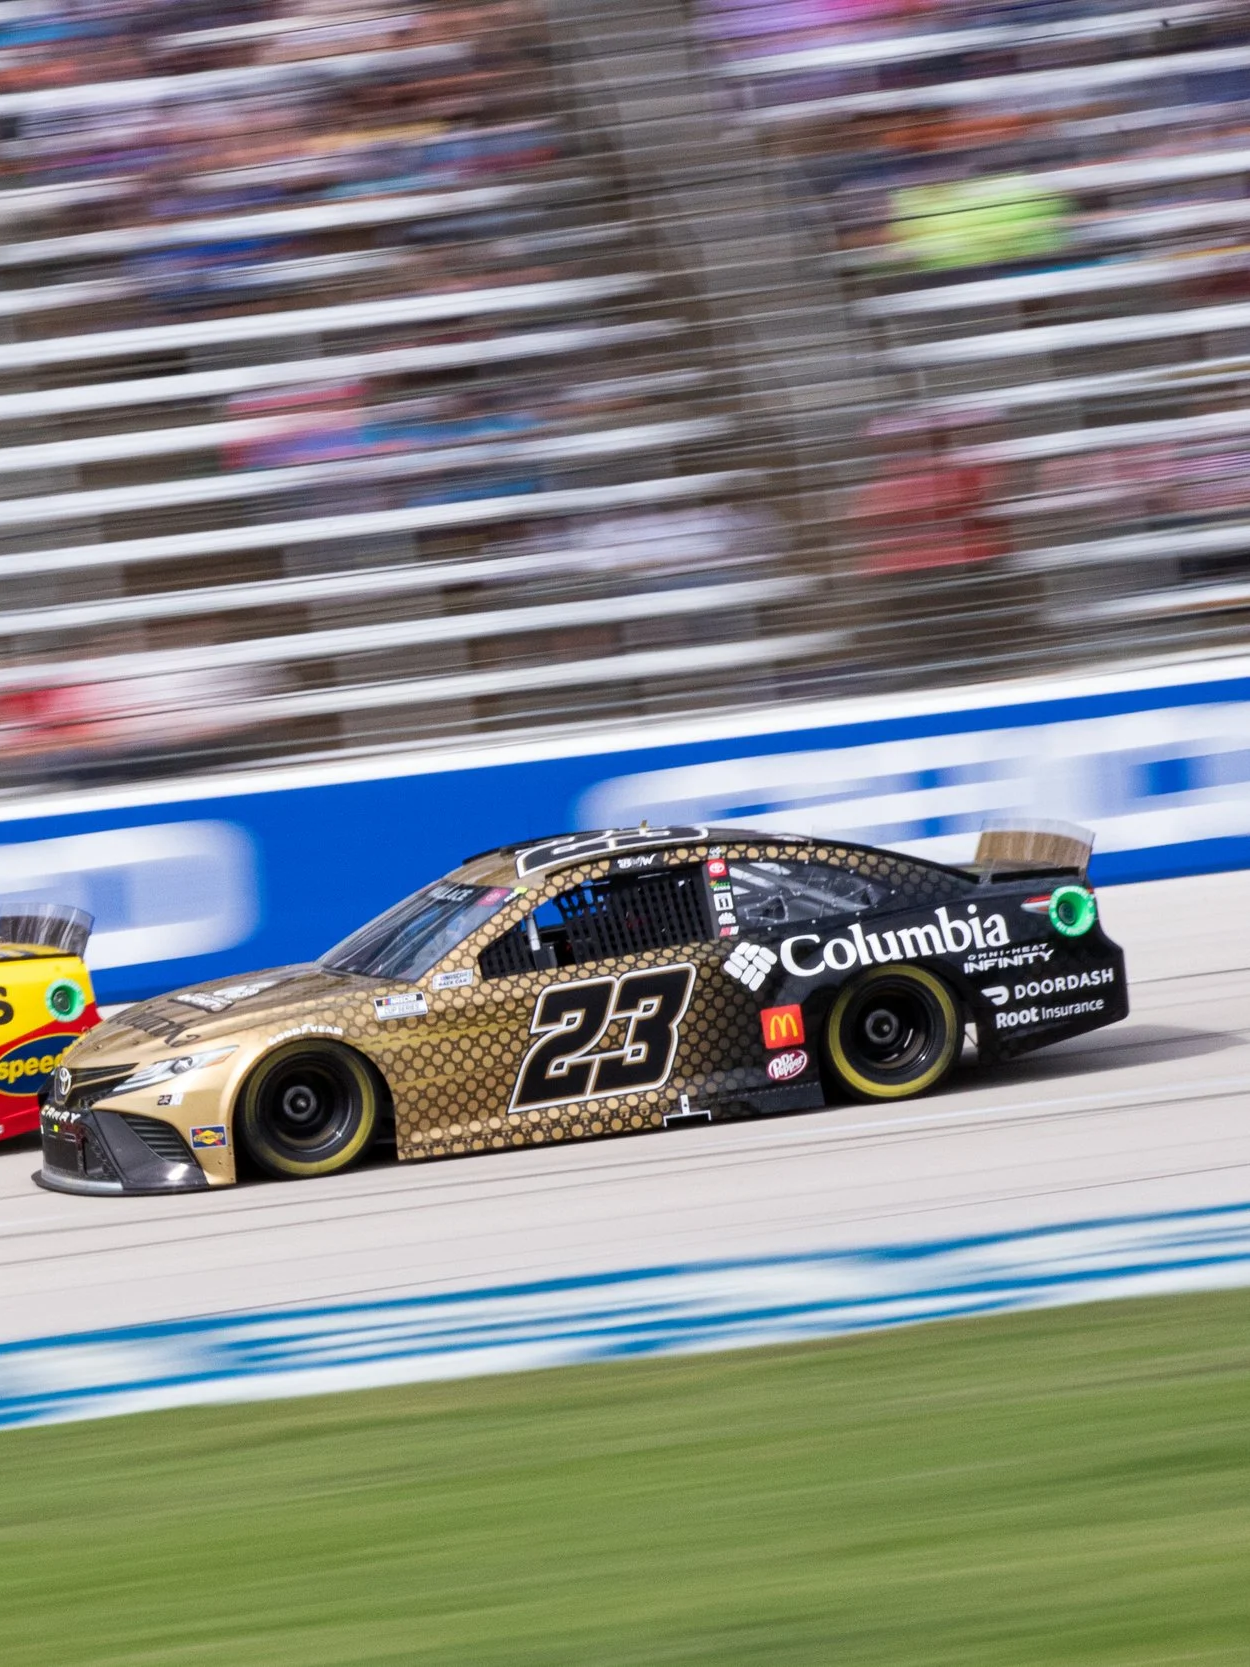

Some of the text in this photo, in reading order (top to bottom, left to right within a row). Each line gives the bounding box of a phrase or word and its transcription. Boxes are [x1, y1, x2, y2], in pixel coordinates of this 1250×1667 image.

[780, 904, 1010, 977] Columbia
[968, 943, 1048, 960] OMNI-HEAT
[963, 949, 1054, 974] INFINITY
[1014, 968, 1114, 999] DOORDASH
[996, 999, 1104, 1029] Root Insurance
[508, 963, 696, 1114] 23
